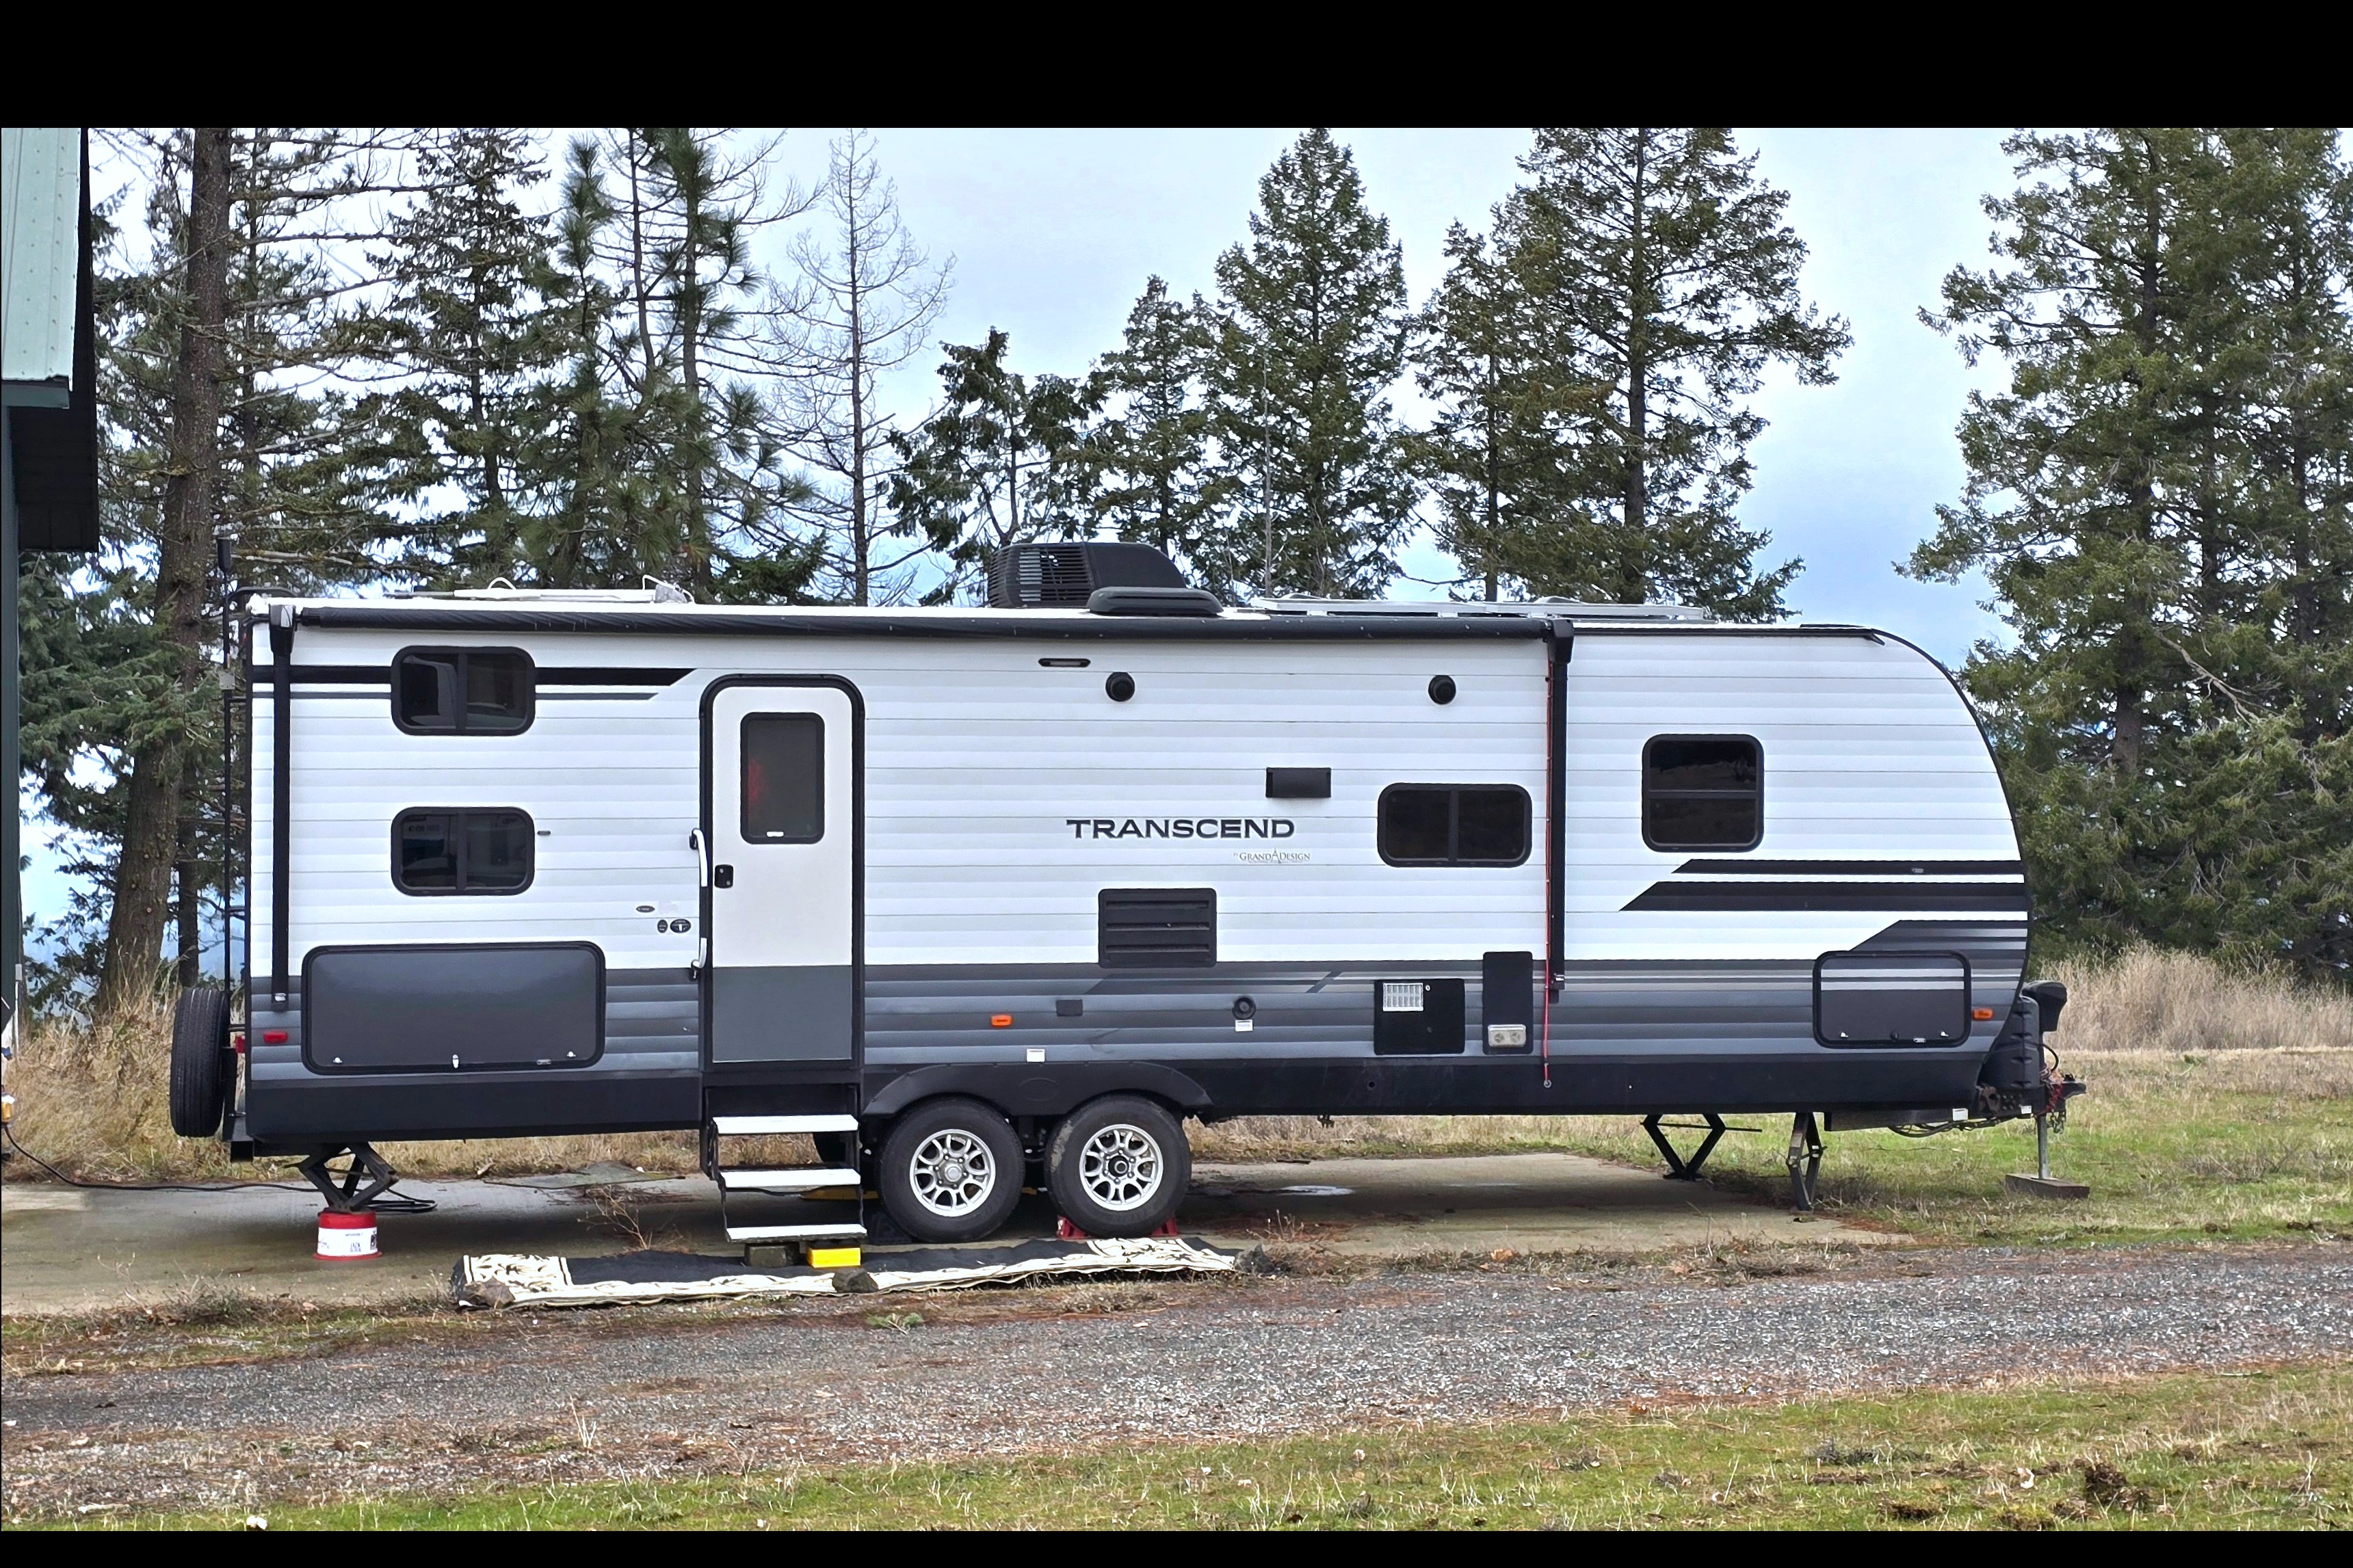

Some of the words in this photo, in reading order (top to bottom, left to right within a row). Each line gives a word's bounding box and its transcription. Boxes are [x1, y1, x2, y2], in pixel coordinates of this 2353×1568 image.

[1066, 819, 1295, 839] TRANSCEND
[1239, 851, 1272, 861] GRAND
[1279, 851, 1311, 861] DESIGN
